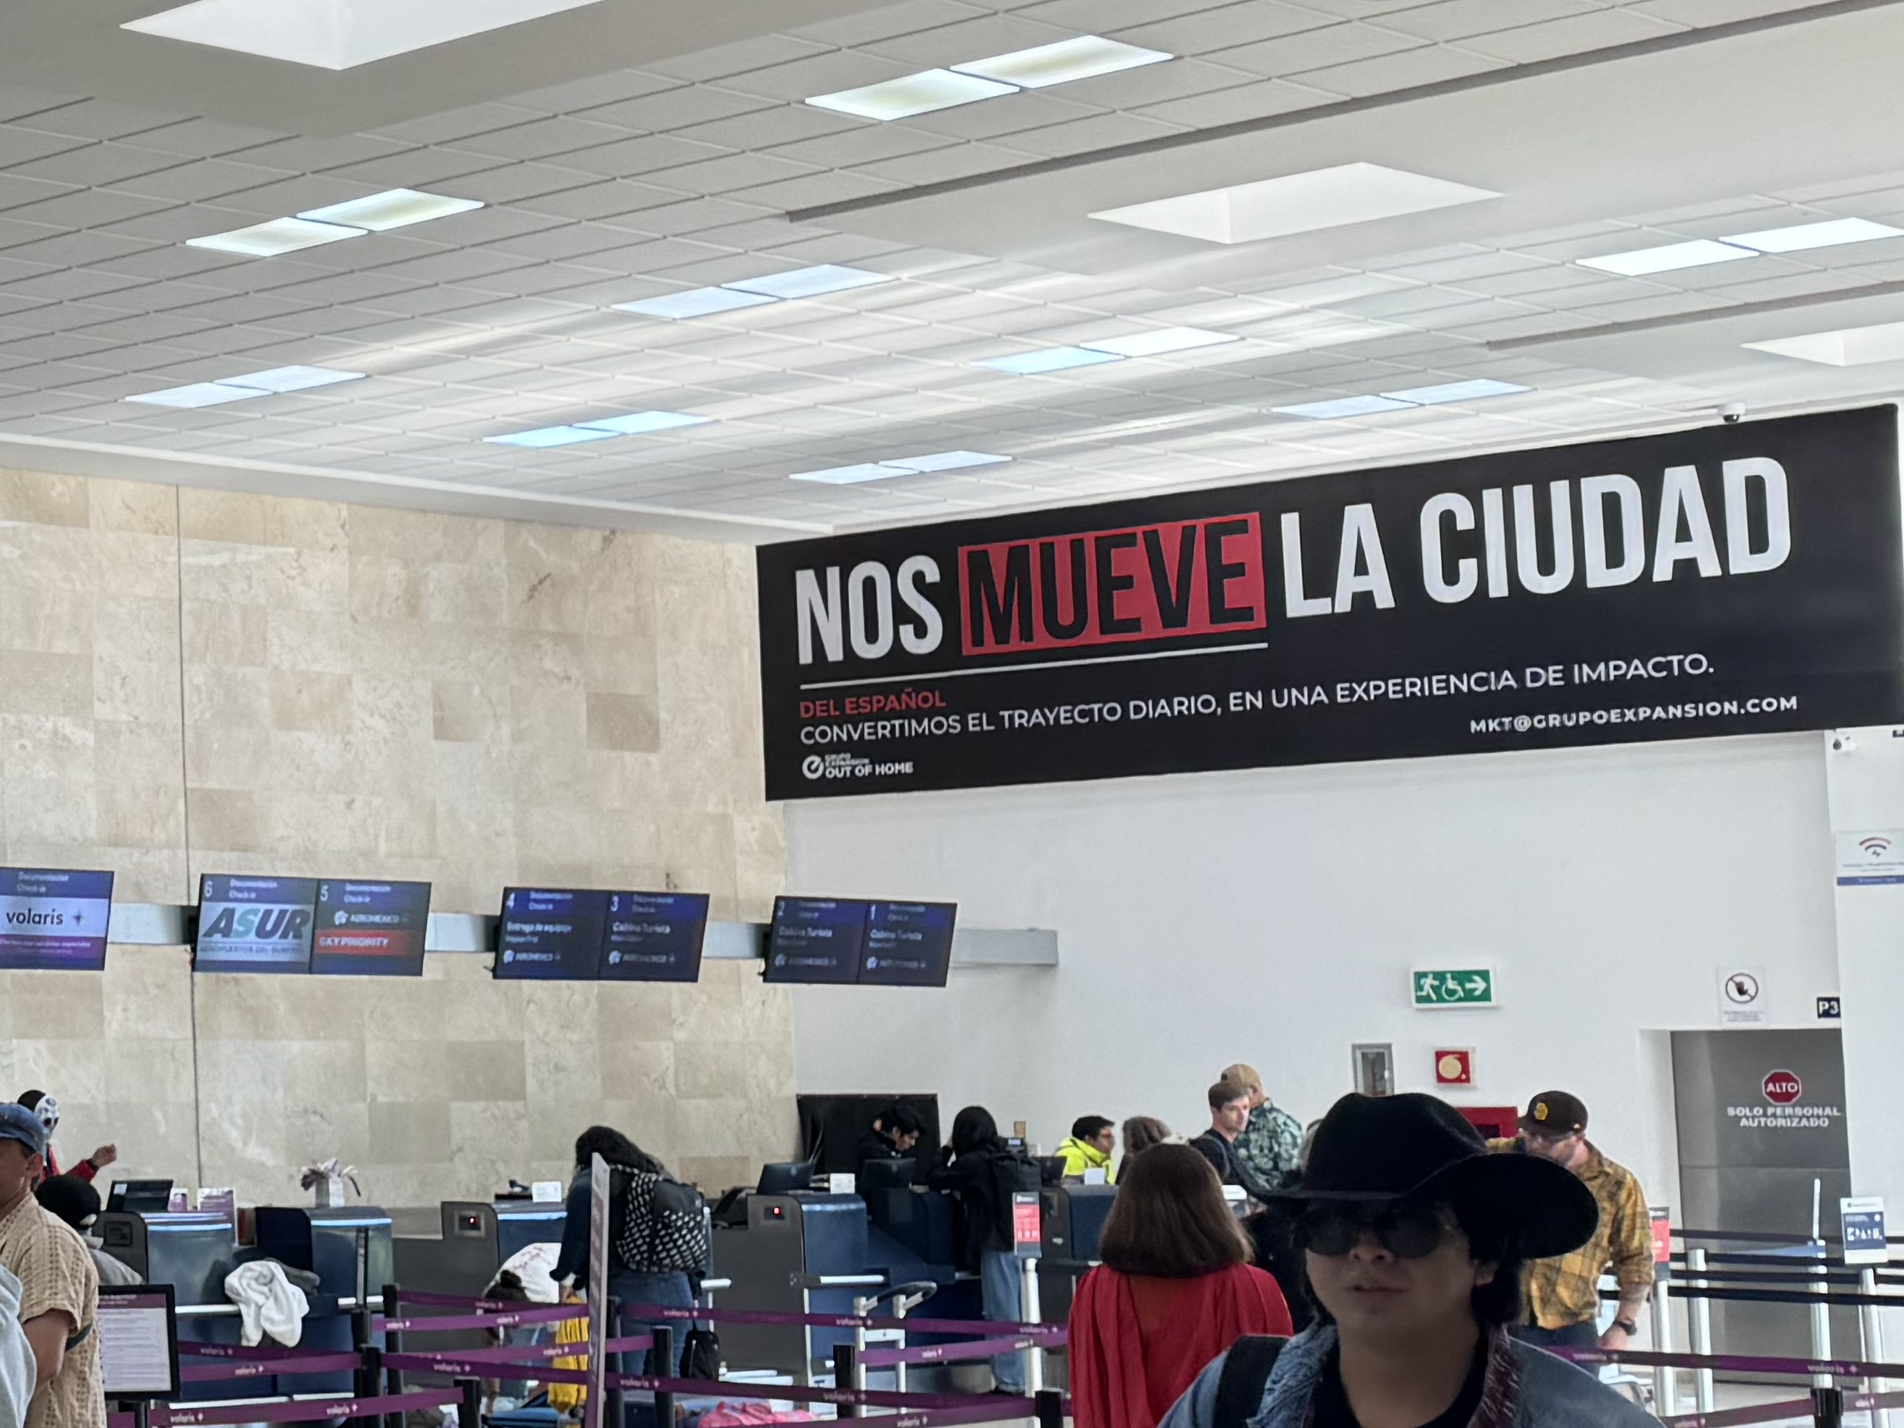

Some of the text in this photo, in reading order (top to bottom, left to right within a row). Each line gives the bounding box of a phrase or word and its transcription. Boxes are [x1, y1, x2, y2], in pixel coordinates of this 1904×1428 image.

[795, 456, 1792, 665] NOS MUEVE LA CIUDAD
[800, 652, 1714, 746] CONVERTIMOS EL TRAYECTO DIARIO, EN UNA EXPERIENCIA DE IMPACTO.
[800, 687, 946, 719] DEL ESPAÑOL
[1469, 694, 1799, 735] MKT@GRUPOEXPANSION.COM
[825, 762, 913, 778] OUT OF HOME
[203, 881, 212, 898] 6
[320, 885, 329, 902] 5
[506, 893, 515, 909] 4
[611, 896, 619, 912] 3
[778, 901, 785, 916] 2
[5, 908, 64, 925] volaris
[870, 904, 877, 920] 1
[202, 907, 312, 940] ASUR
[1818, 1001, 1839, 1014] P3
[1766, 1083, 1798, 1093] ALTO
[1727, 1106, 1841, 1116] SOLO PERSONAL
[1740, 1117, 1829, 1127] AUTORIZADO
[434, 1363, 461, 1372] volaris
[619, 1378, 649, 1388] volaris
[170, 1412, 195, 1423] volaris
